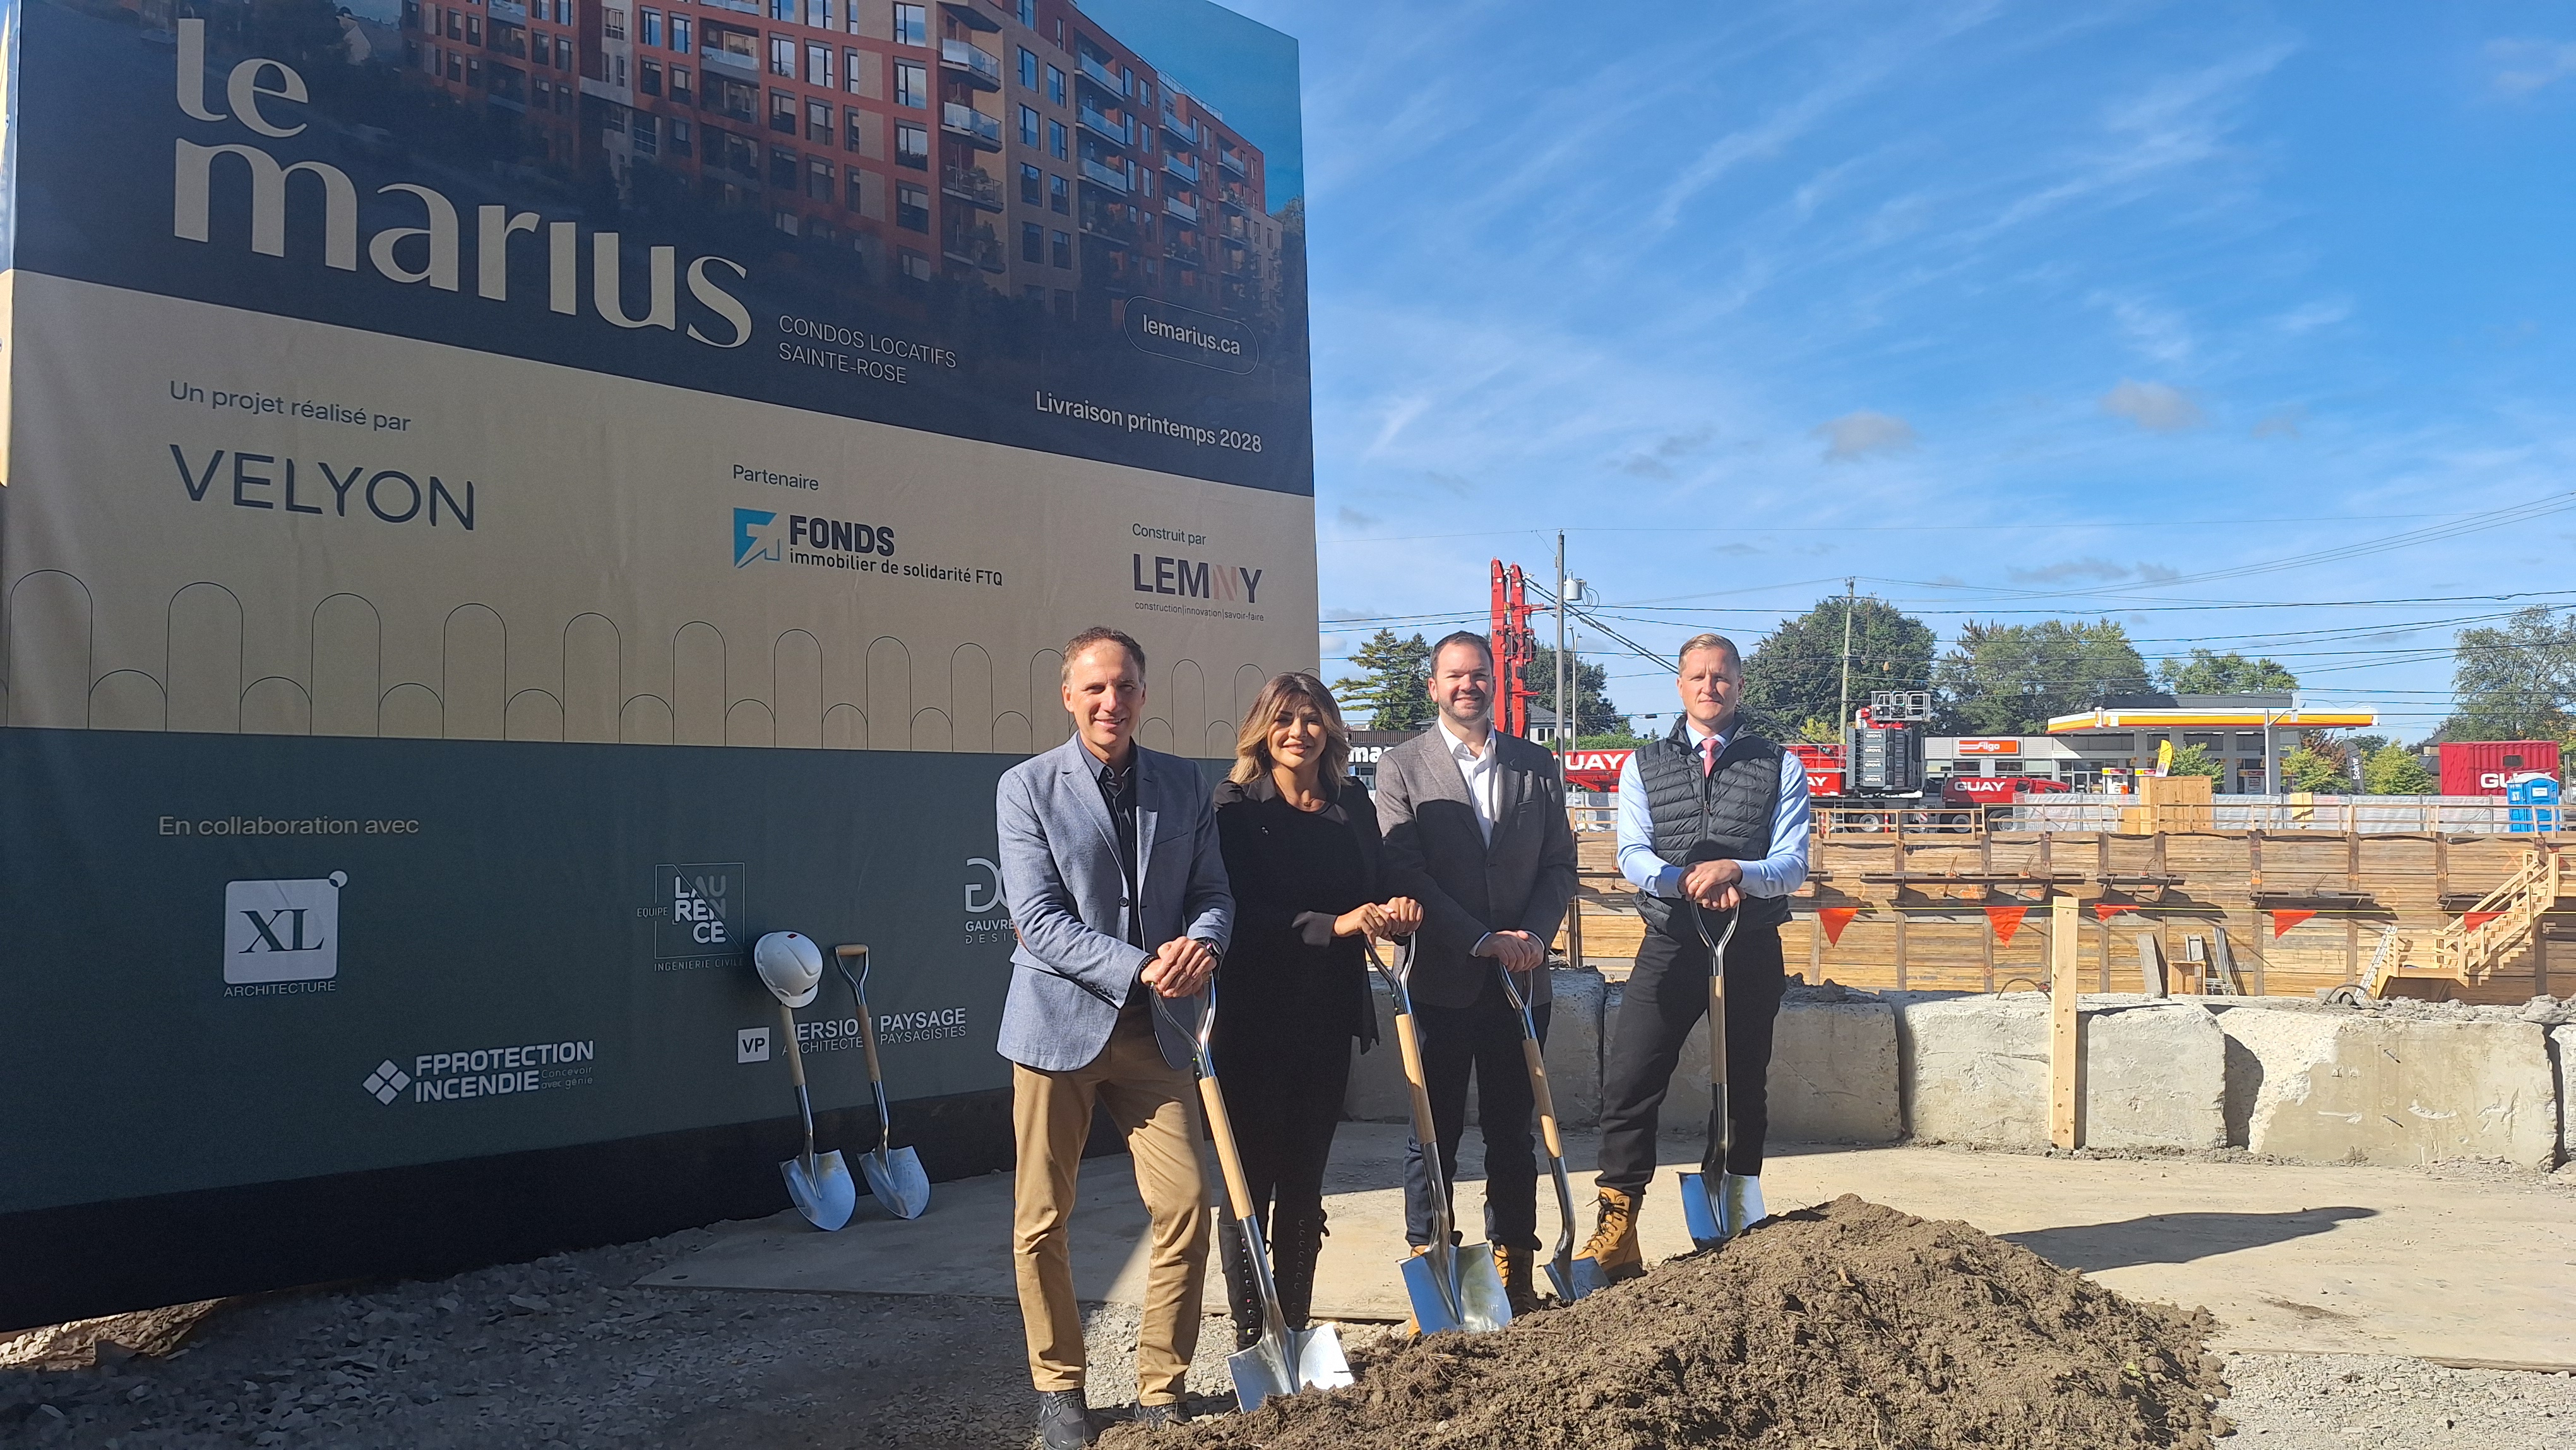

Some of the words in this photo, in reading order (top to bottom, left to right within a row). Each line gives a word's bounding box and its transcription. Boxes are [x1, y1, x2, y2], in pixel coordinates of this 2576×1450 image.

[177, 18, 309, 138] le
[174, 138, 753, 349] marius
[778, 315, 866, 349] CONDOS
[869, 333, 957, 369] LOCATIFS
[1143, 314, 1241, 356] lemarius.ca
[778, 342, 908, 385] SAINTE-ROSE
[169, 380, 205, 403] Un
[212, 390, 285, 415] projet
[291, 400, 367, 426] réalisé
[373, 412, 412, 432] par
[1035, 390, 1123, 428] Livraison
[1127, 412, 1216, 447] printemps
[1219, 428, 1263, 453] 2028
[169, 443, 475, 531] VELYON
[732, 464, 820, 491] Partenaire
[789, 514, 895, 557] FONDS
[1132, 523, 1186, 544] Construit
[1188, 534, 1207, 547] par
[789, 548, 878, 573] immobilier
[881, 560, 899, 575] de
[903, 563, 972, 584] solidarité
[975, 570, 1003, 587] FTQ
[1133, 553, 1263, 604] LEMNY
[1348, 746, 1395, 764] ma
[1553, 753, 1625, 770] UAY
[1954, 781, 2006, 792] GUAY
[158, 815, 191, 836] En
[197, 815, 359, 836] collaboration
[364, 819, 420, 834] avec
[636, 906, 668, 918] EQUIPE
[238, 908, 325, 954] XL
[693, 921, 727, 944] CE
[654, 959, 710, 972] INGENIERIE
[224, 980, 337, 998] ARCHITECTURE
[794, 1017, 872, 1041] ERSIO
[880, 1007, 966, 1033] PAYSAGE
[880, 1026, 966, 1046] PAYSAGISTES
[415, 1040, 594, 1077] FPROTECTION
[741, 1037, 766, 1054] VP
[415, 1070, 540, 1103] INCENDIE
[541, 1066, 592, 1079] Concevoir
[541, 1080, 562, 1089] avec
